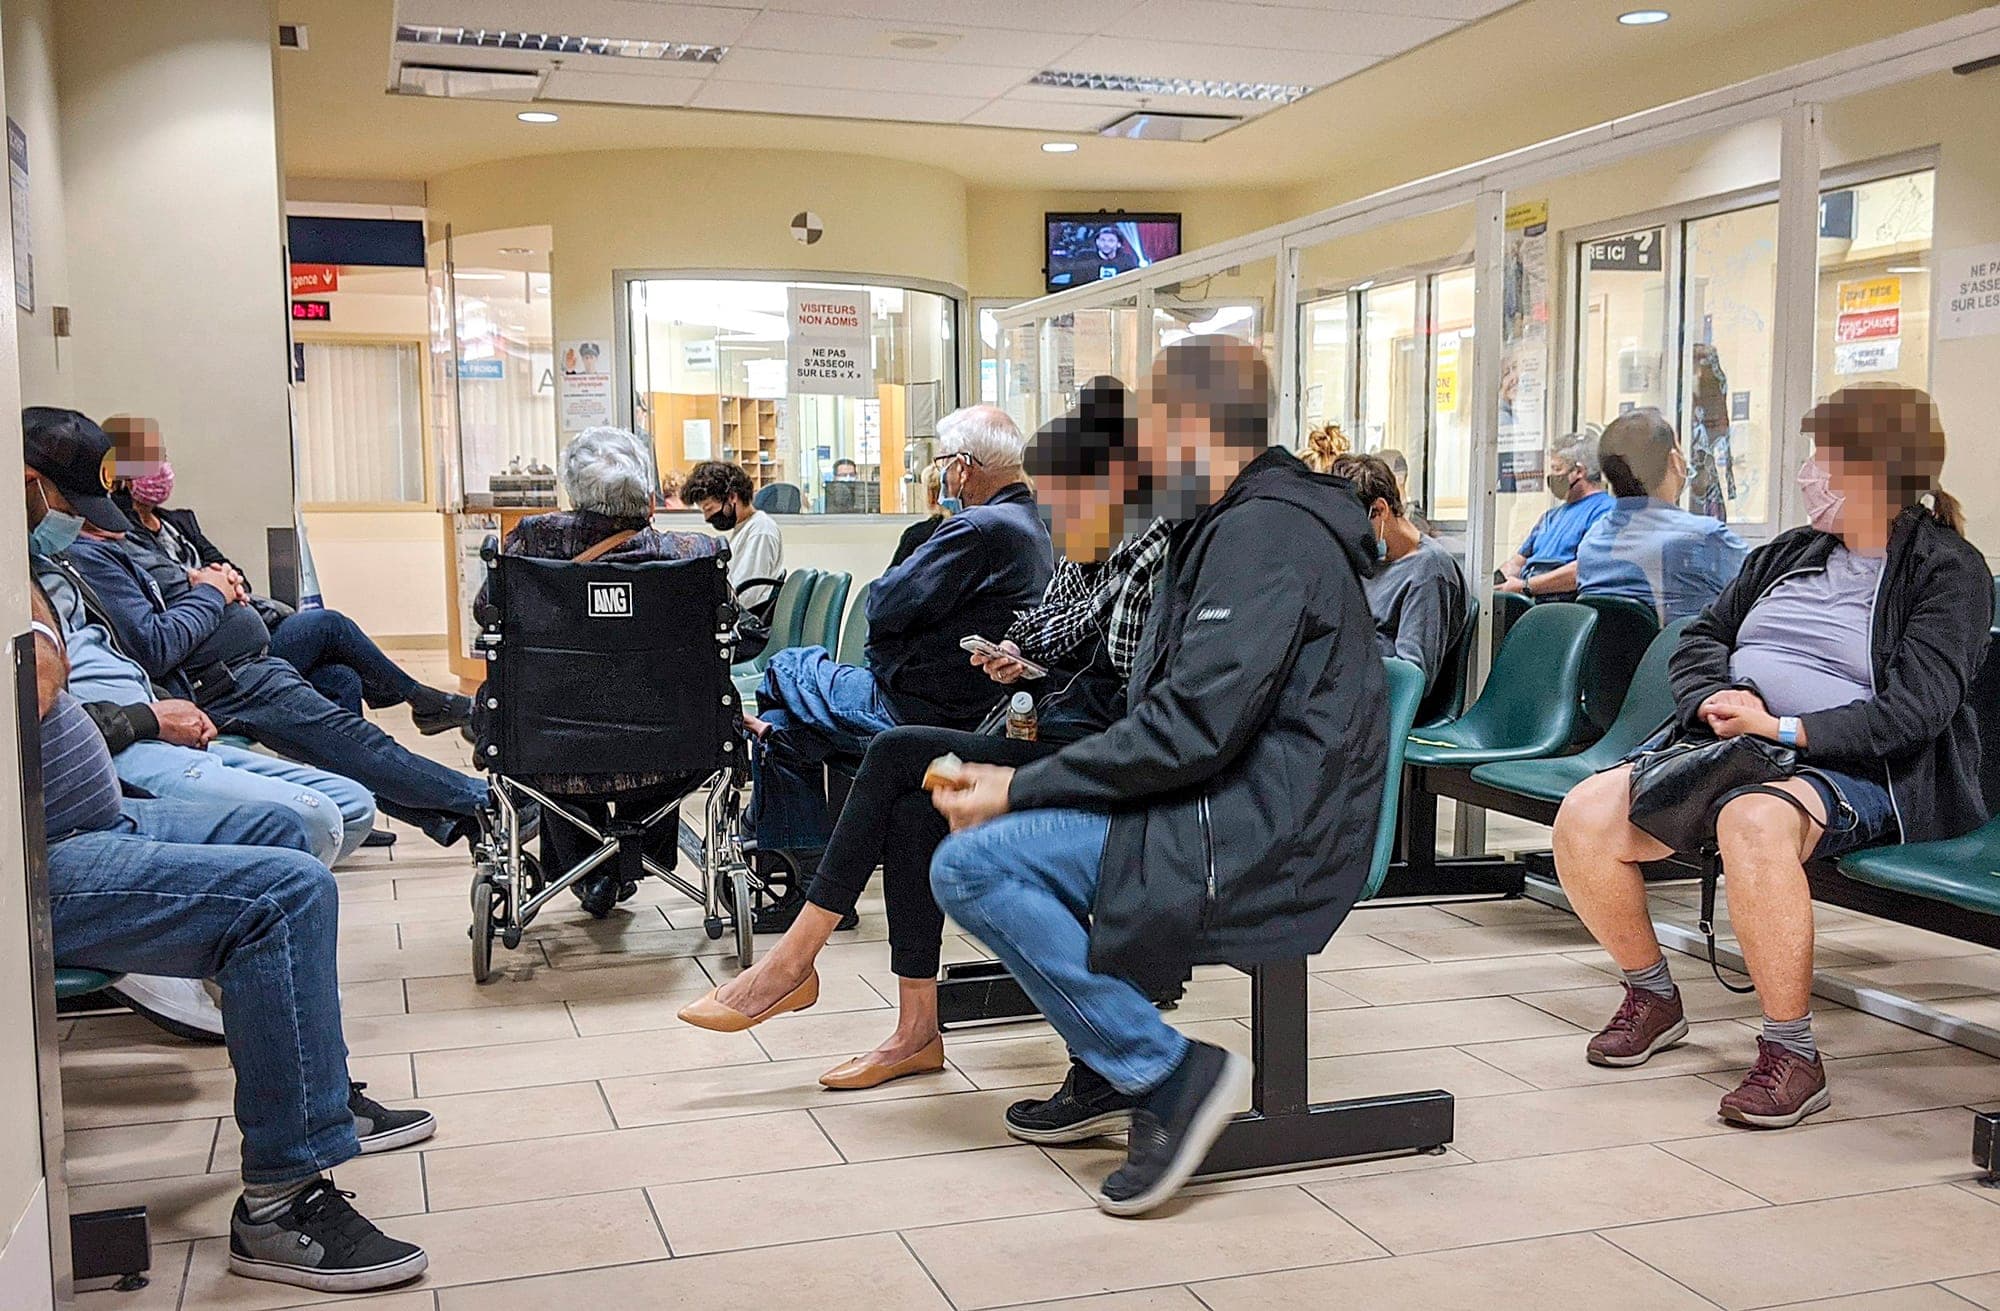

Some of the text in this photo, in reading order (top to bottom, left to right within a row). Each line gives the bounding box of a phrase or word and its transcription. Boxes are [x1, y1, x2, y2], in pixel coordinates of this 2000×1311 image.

[1607, 245, 1626, 260] ICI
[1970, 263, 1986, 278] NE
[800, 303, 857, 315] VISITEURS
[1951, 294, 2000, 312] SUR LES
[798, 315, 858, 327] NON ADMIS
[1862, 316, 1897, 332] CHAUDE
[812, 348, 846, 359] NE PAS
[803, 358, 855, 369] S'ASSEOIR
[797, 368, 817, 378] SUR
[819, 369, 838, 379] LES
[847, 370, 854, 379] X
[594, 586, 627, 613] AMG
